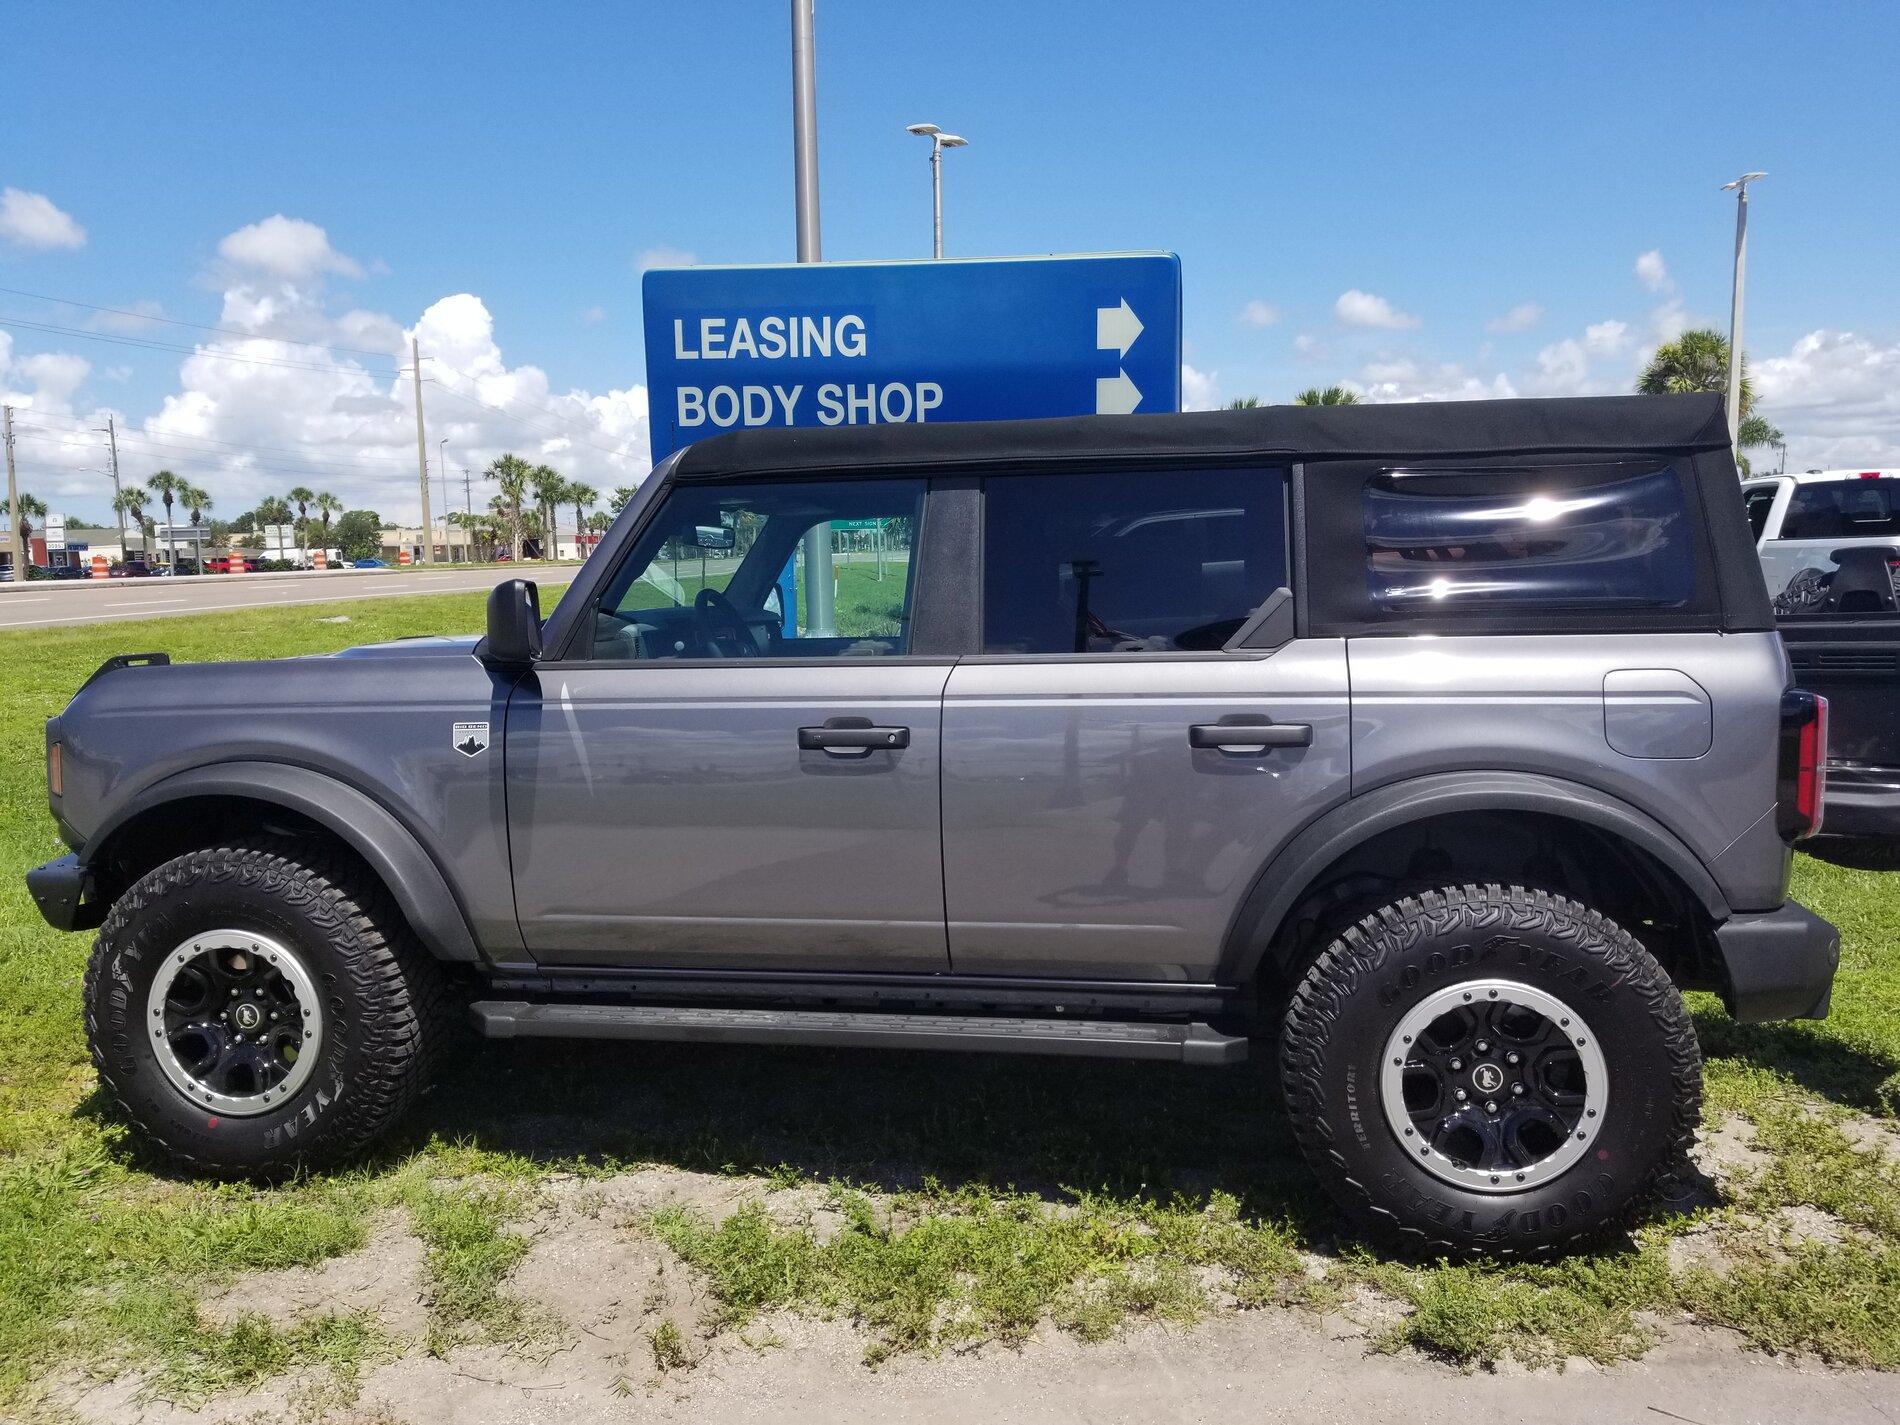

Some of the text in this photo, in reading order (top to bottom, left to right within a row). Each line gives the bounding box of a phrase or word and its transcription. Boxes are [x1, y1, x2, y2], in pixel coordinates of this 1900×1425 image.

[674, 314, 867, 360] LEASING
[676, 382, 944, 427] BODY SHOP
